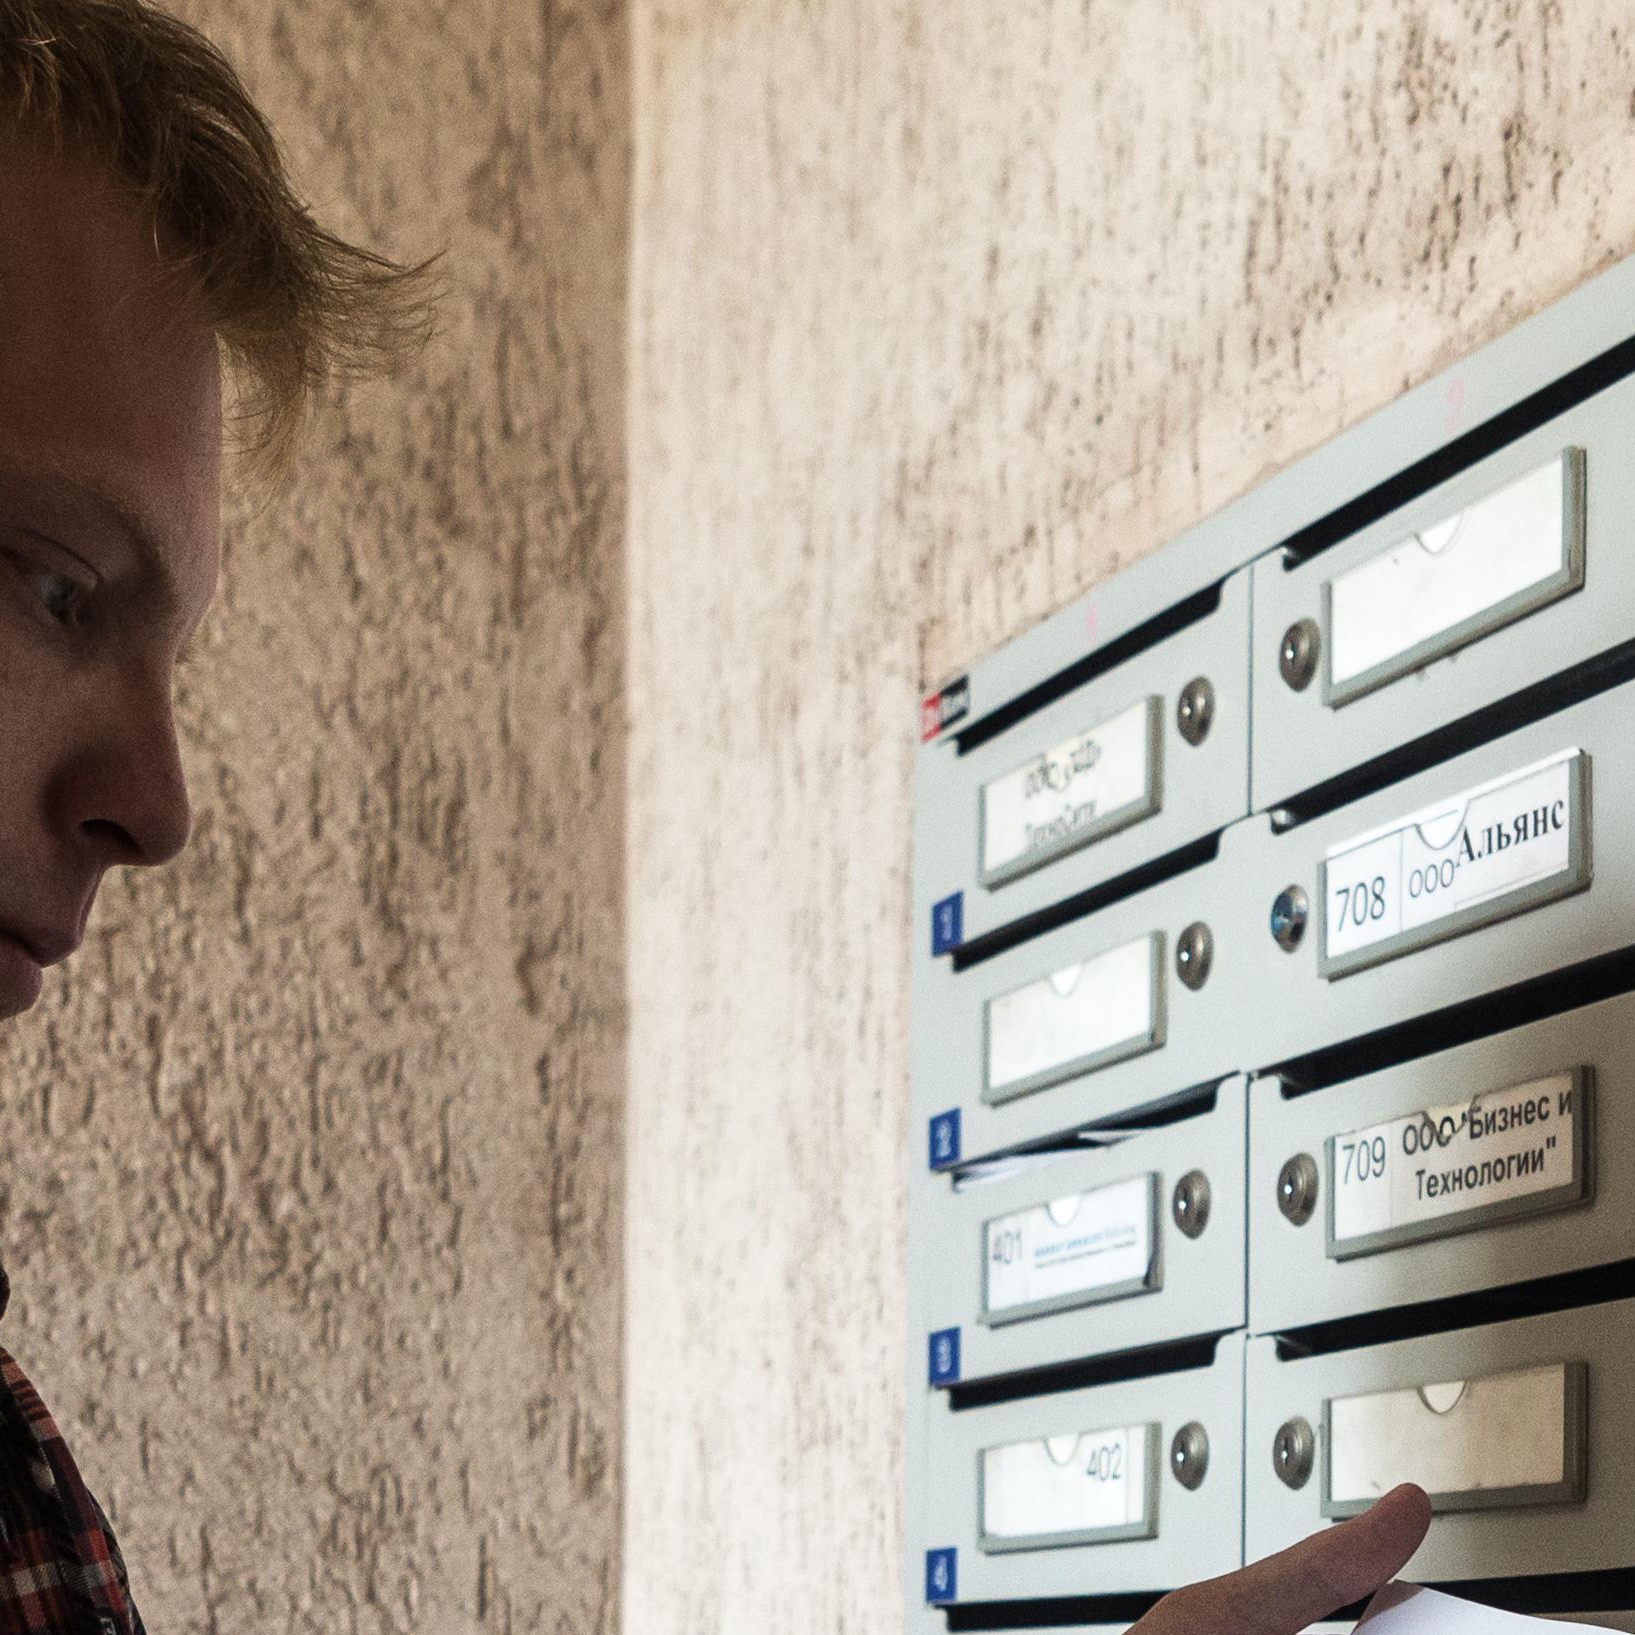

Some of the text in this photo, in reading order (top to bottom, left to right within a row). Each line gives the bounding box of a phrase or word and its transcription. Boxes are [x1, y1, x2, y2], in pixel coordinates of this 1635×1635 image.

[1409, 799, 1566, 899] ООО Альянс
[1336, 877, 1386, 932] 708
[1342, 1136, 1386, 1185] 709
[1402, 1114, 1457, 1156] ООО
[1415, 1136, 1557, 1200] Технологии"
[1086, 1443, 1122, 1481] 402
